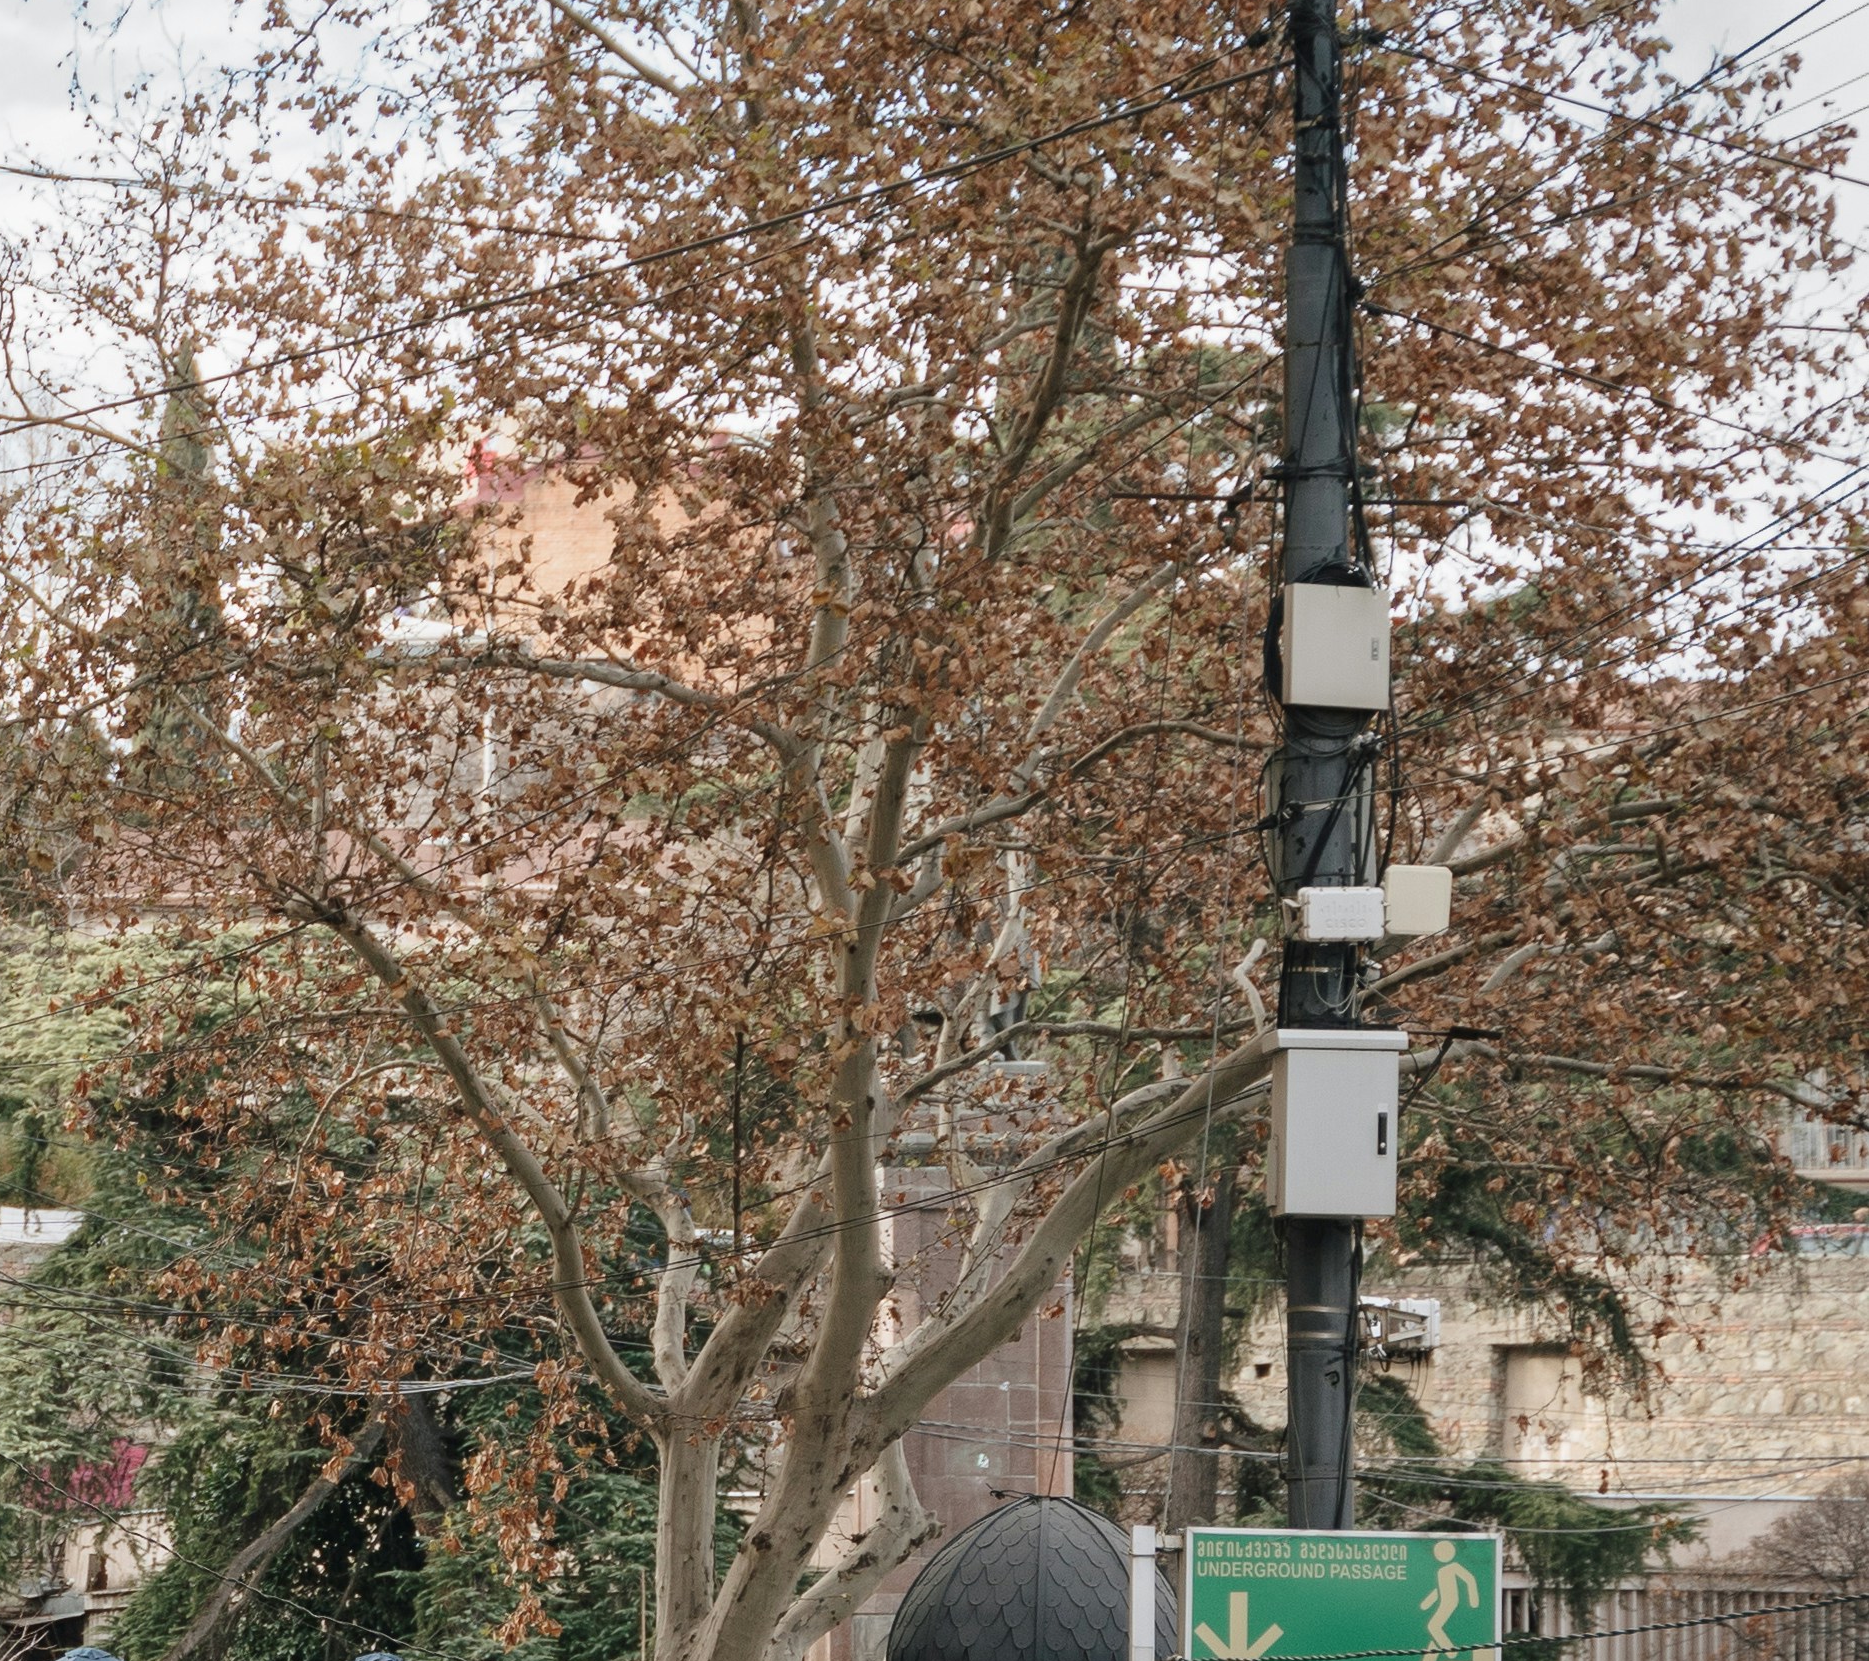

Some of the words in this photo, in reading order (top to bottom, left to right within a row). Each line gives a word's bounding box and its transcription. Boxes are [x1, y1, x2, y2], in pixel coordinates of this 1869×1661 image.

[1326, 918, 1366, 929] CISCO
[1197, 1540, 1291, 1559] მიწისქვეშა
[1300, 1542, 1408, 1561] გადასასვლელი
[1197, 1561, 1326, 1579] UNDERGROUND
[1330, 1563, 1407, 1580] PASSAGE
